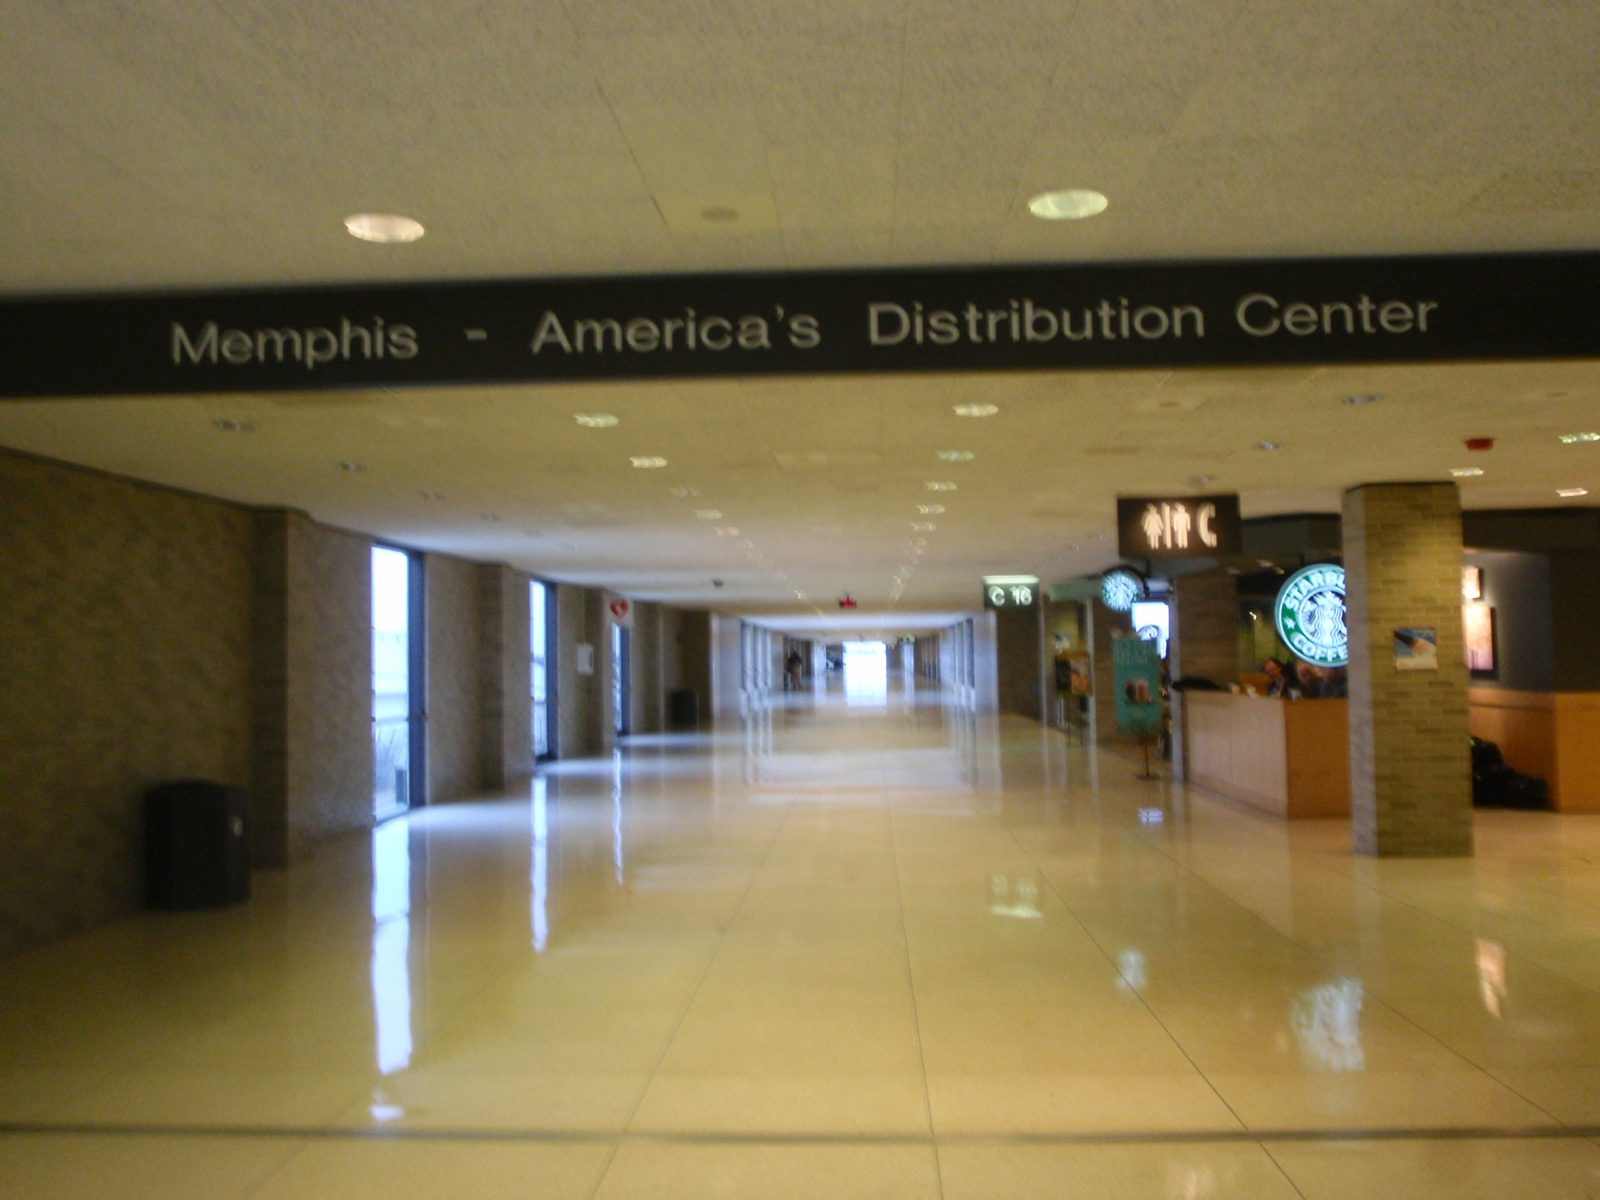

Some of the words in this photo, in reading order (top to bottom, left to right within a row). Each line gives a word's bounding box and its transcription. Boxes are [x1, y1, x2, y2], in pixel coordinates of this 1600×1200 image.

[172, 318, 419, 369] Memphis
[531, 305, 821, 354] America's
[868, 297, 1204, 346] Distribution
[1236, 292, 1438, 336] Center
